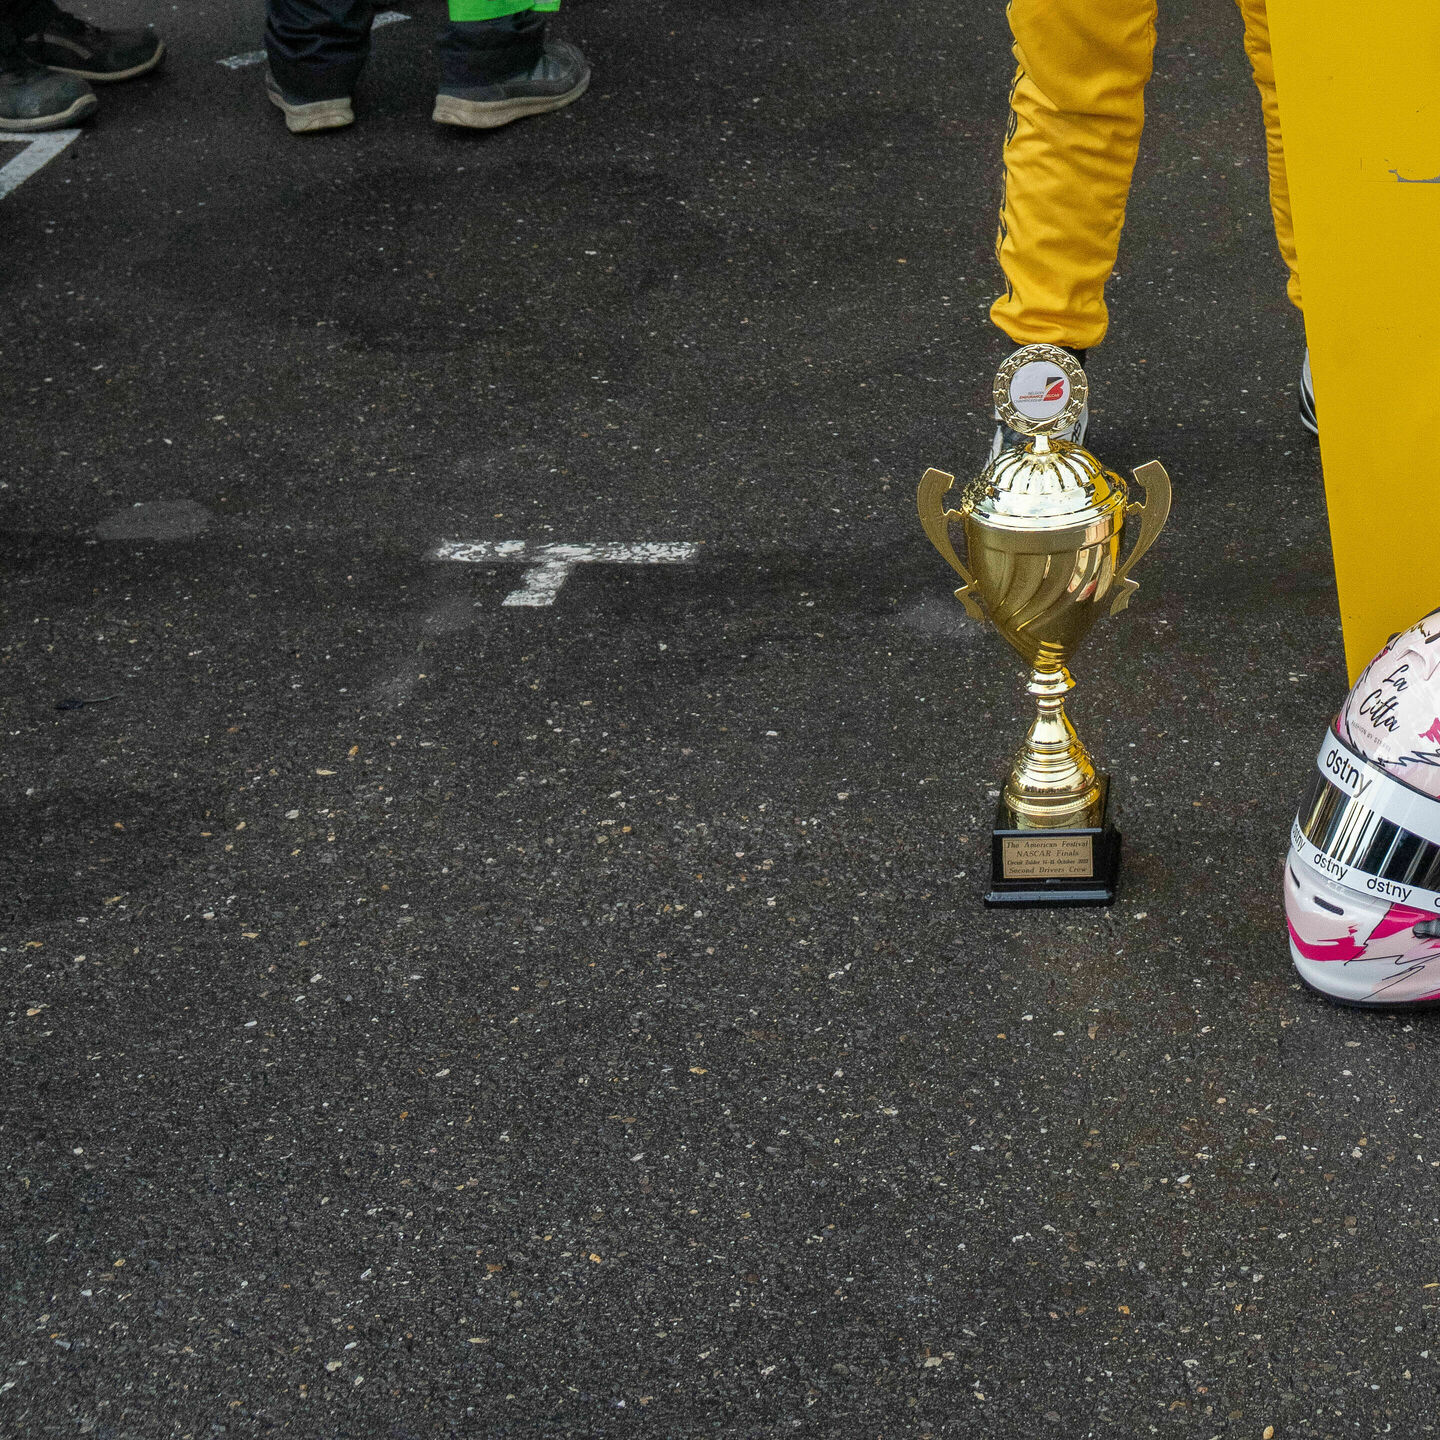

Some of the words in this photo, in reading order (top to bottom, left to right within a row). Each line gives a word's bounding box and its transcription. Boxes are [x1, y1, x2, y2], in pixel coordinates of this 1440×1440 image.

[1382, 663, 1409, 692] La
[1325, 748, 1373, 799] dstny
[1016, 850, 1052, 858] NASCAR
[1313, 851, 1349, 881] dstny
[1366, 875, 1413, 903] dstny
